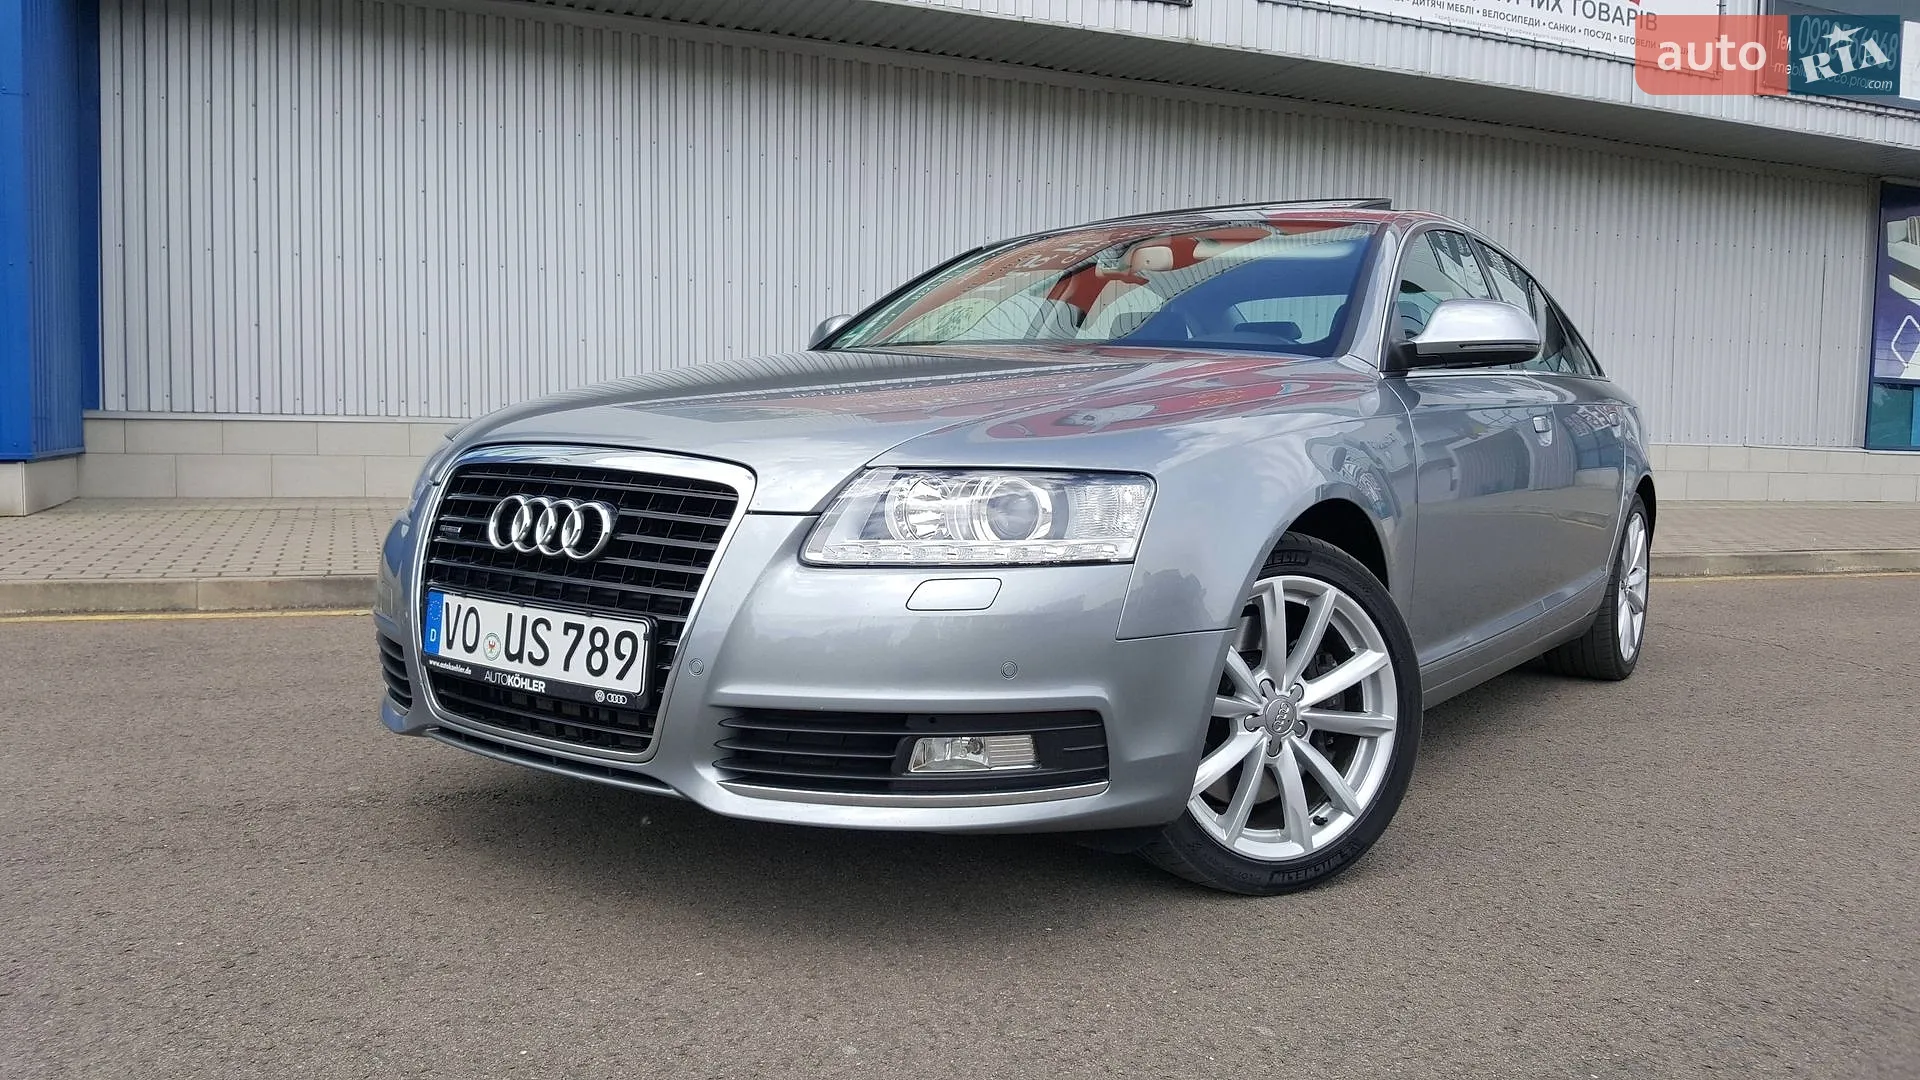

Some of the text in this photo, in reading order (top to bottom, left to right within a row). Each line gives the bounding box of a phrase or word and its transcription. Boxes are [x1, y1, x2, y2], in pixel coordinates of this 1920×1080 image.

[1412, 0, 1445, 9] ДИТЯЧІ
[1446, 2, 1474, 15] МЕБЛІ
[1482, 8, 1541, 27] ВЕЛОСИПЕДИ
[1548, 21, 1576, 34] САНКИ
[1584, 28, 1612, 42] ПОСУД
[1619, 34, 1656, 49] БІГОВЕЛИ
[1570, 0, 1657, 31] ТОВАРІВ
[430, 628, 436, 642] D
[445, 602, 639, 681] VO US 789
[484, 670, 546, 693] AUTOKÖHLER
